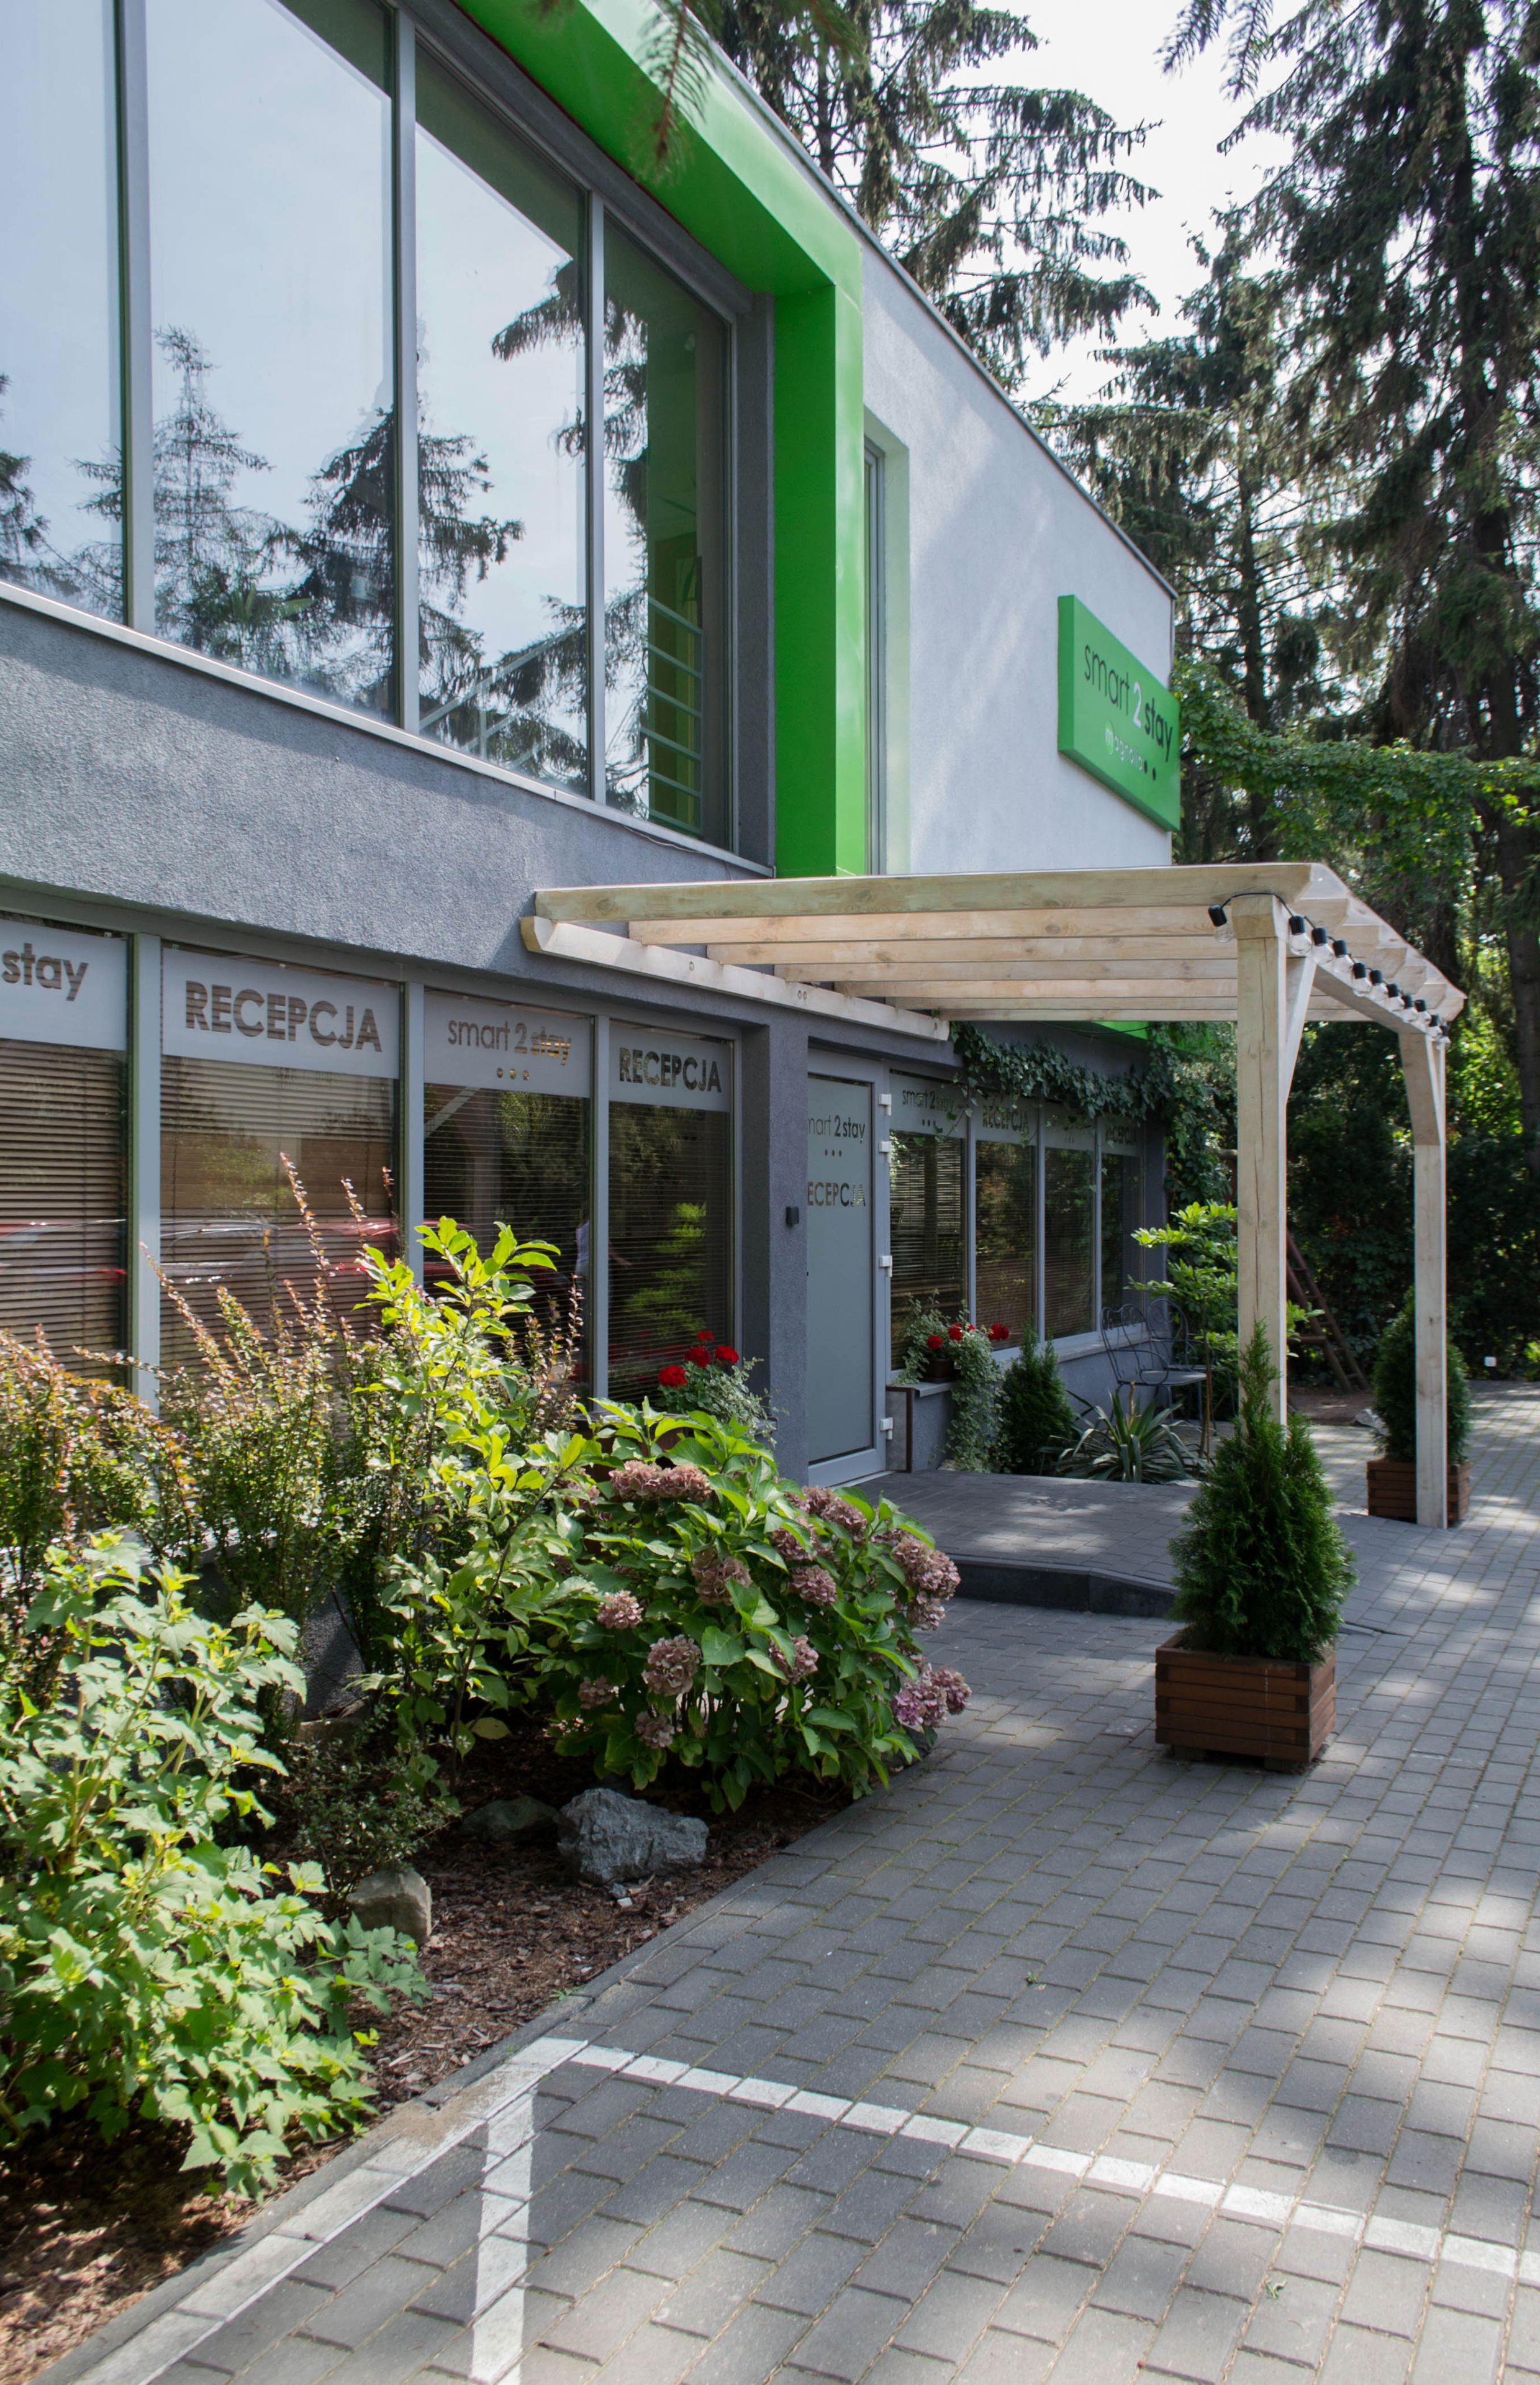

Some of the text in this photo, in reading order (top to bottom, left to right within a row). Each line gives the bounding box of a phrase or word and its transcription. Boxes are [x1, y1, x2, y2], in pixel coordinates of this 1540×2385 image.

[2, 942, 89, 1002] stay
[186, 979, 383, 1052] RECEPCJA
[619, 1047, 722, 1093] RECEPCJA
[807, 1181, 866, 1207] ECEPCJA
